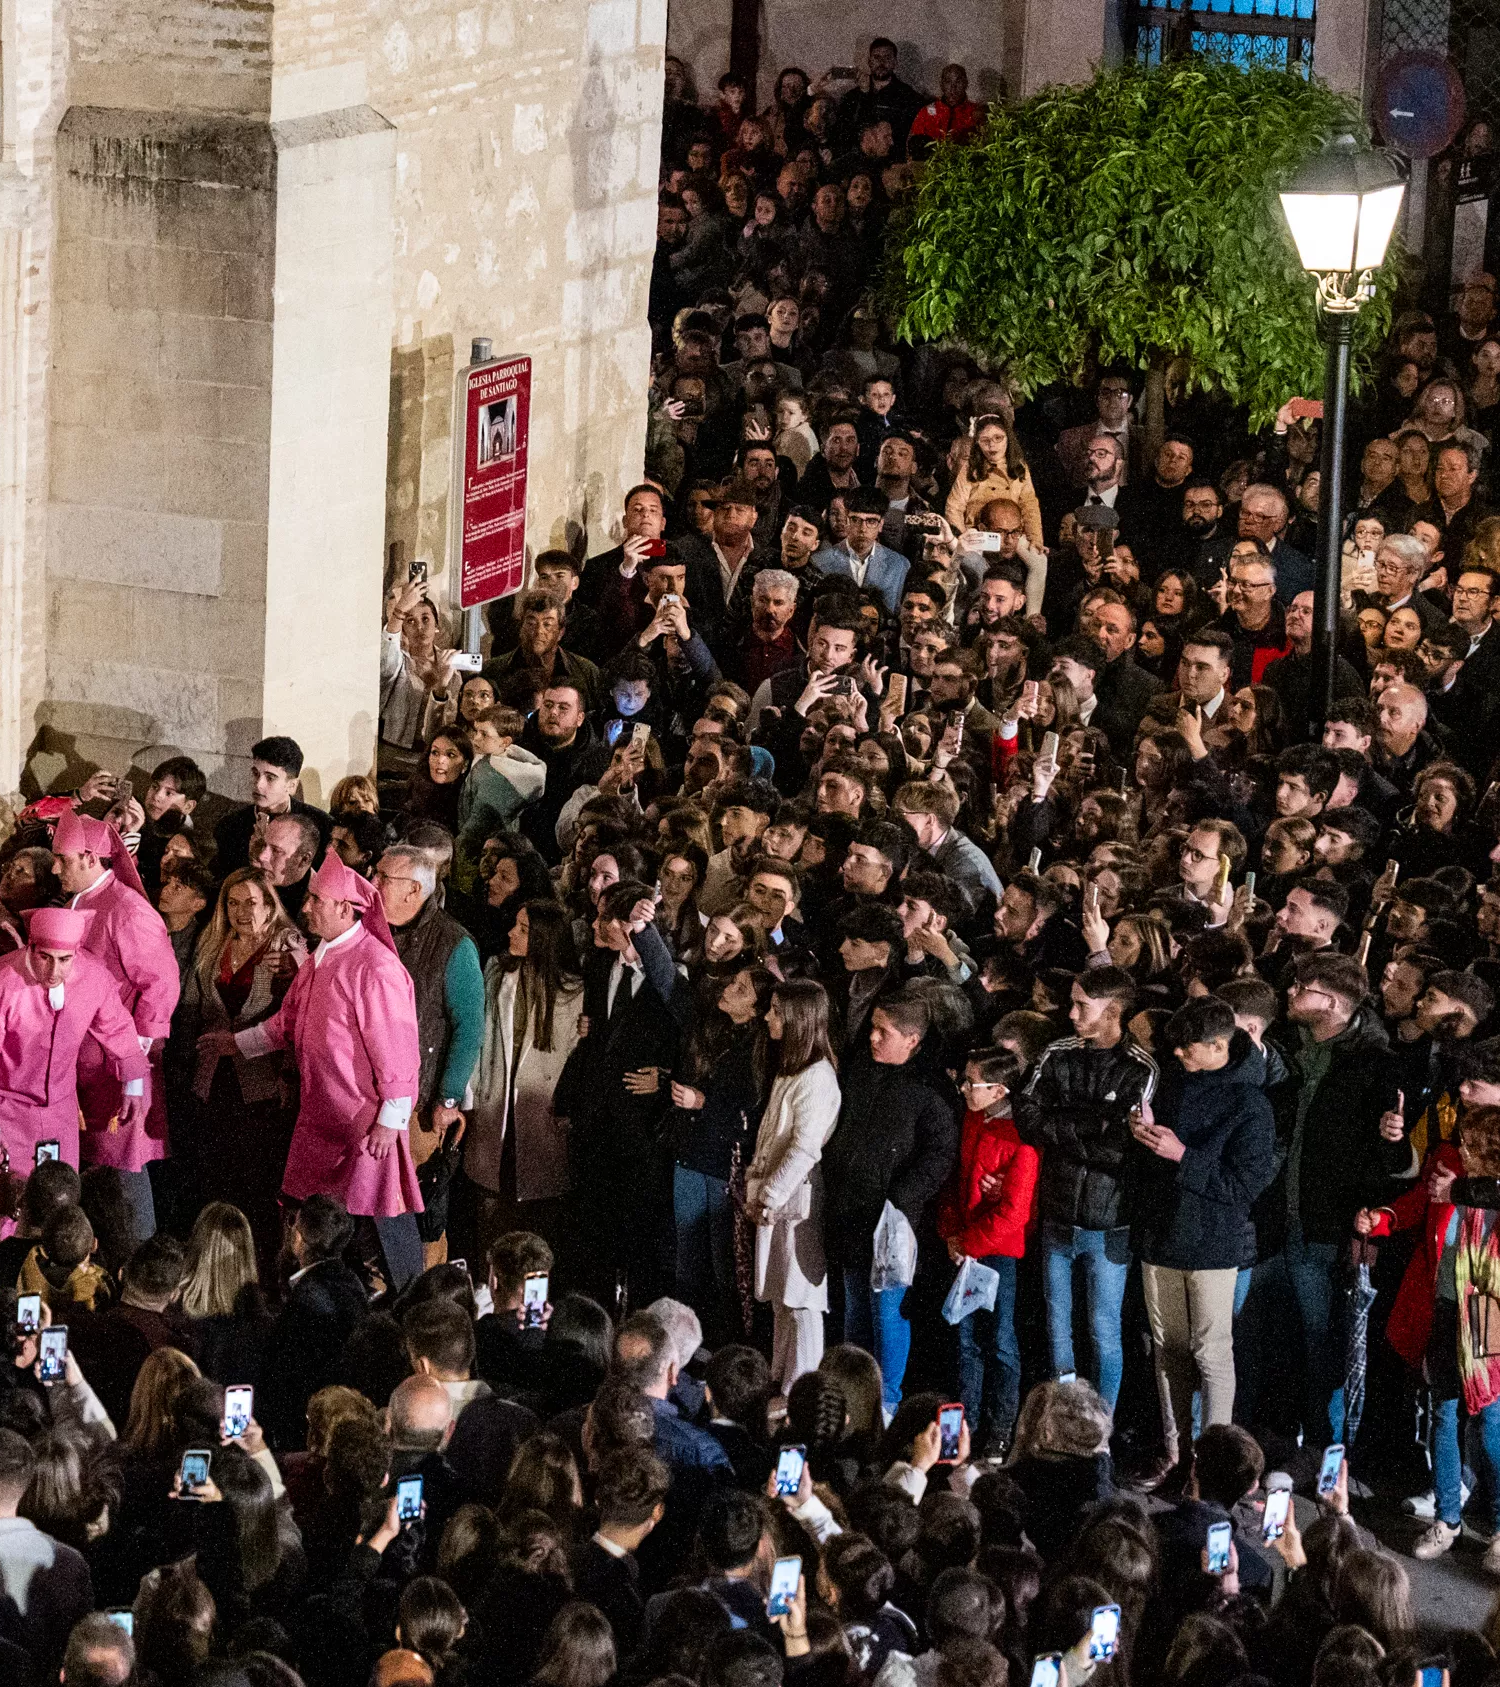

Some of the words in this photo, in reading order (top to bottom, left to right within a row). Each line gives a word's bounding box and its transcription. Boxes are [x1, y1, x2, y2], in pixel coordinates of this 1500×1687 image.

[469, 374, 492, 390] IGLESIA
[493, 361, 528, 381] PARROQUIAL
[480, 387, 488, 400] DE
[488, 379, 518, 397] SANTIAGO
